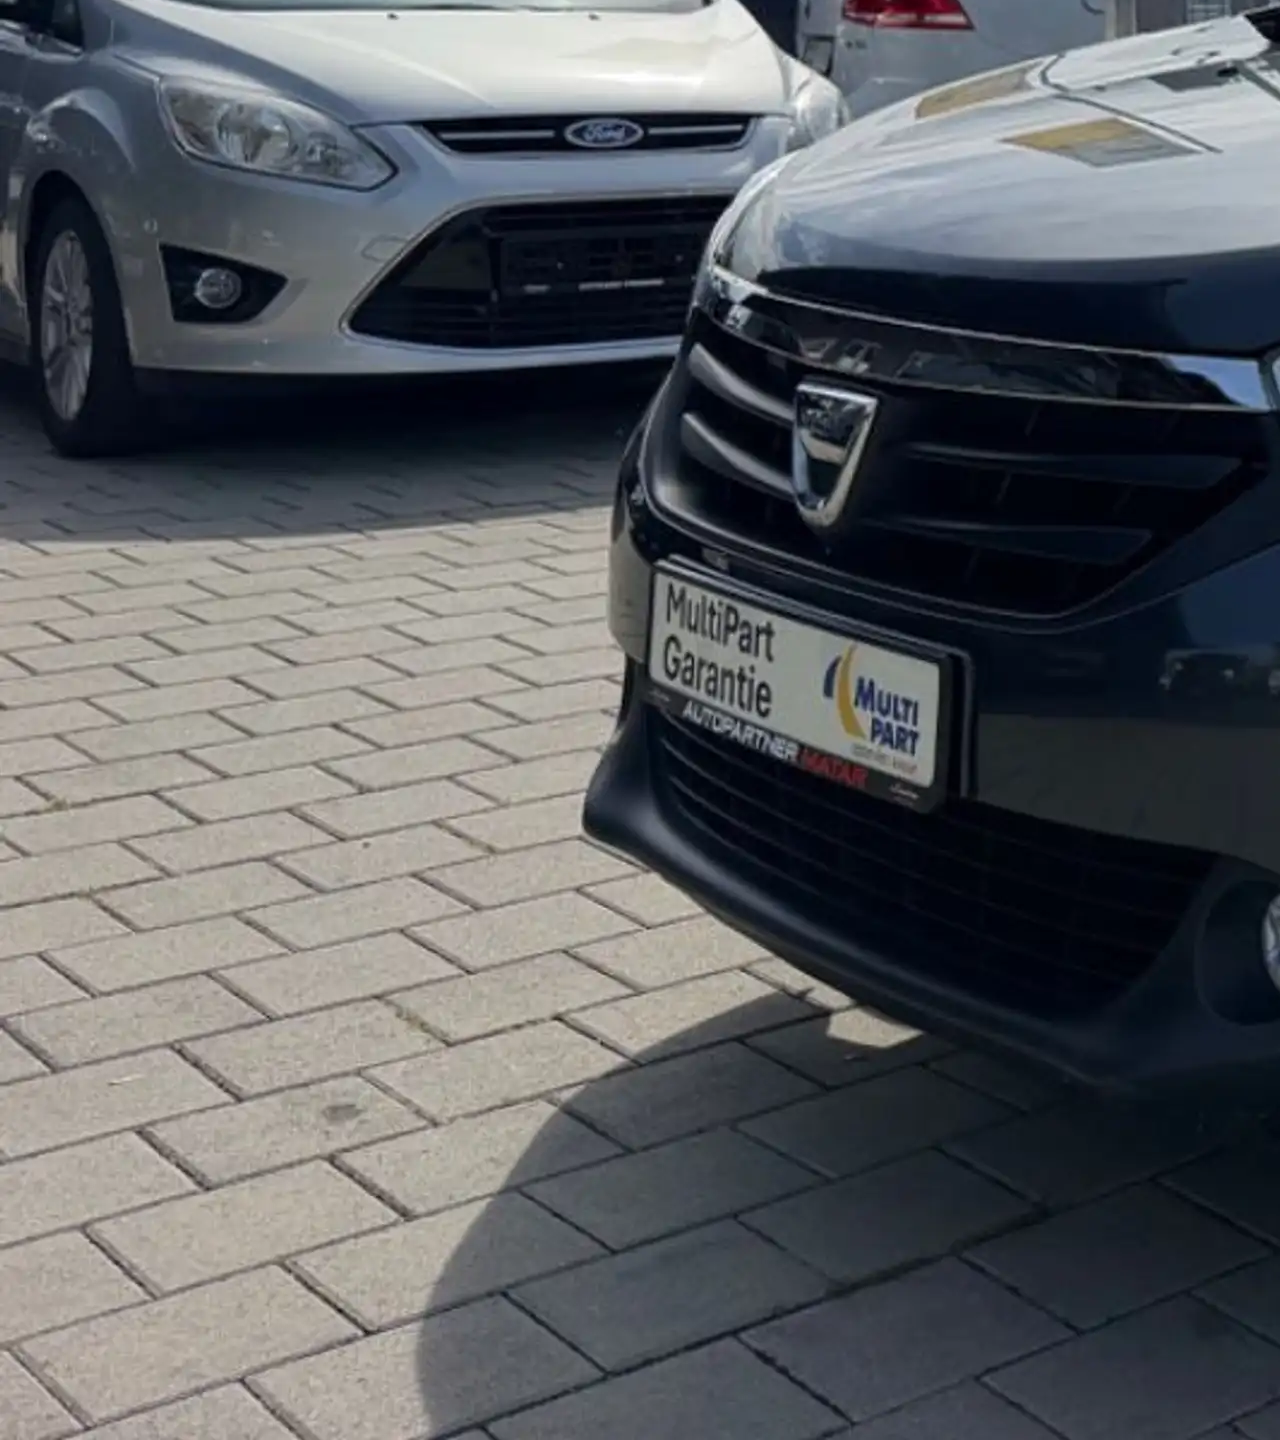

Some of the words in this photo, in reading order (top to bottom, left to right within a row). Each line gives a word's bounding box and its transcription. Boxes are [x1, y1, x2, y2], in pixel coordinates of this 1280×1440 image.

[582, 123, 625, 142] Ford
[666, 581, 775, 663] MultiPart
[663, 633, 773, 719] Garantie
[853, 675, 919, 727] MULTI
[682, 699, 798, 761] AUTOPARTNER
[870, 716, 920, 757] PART
